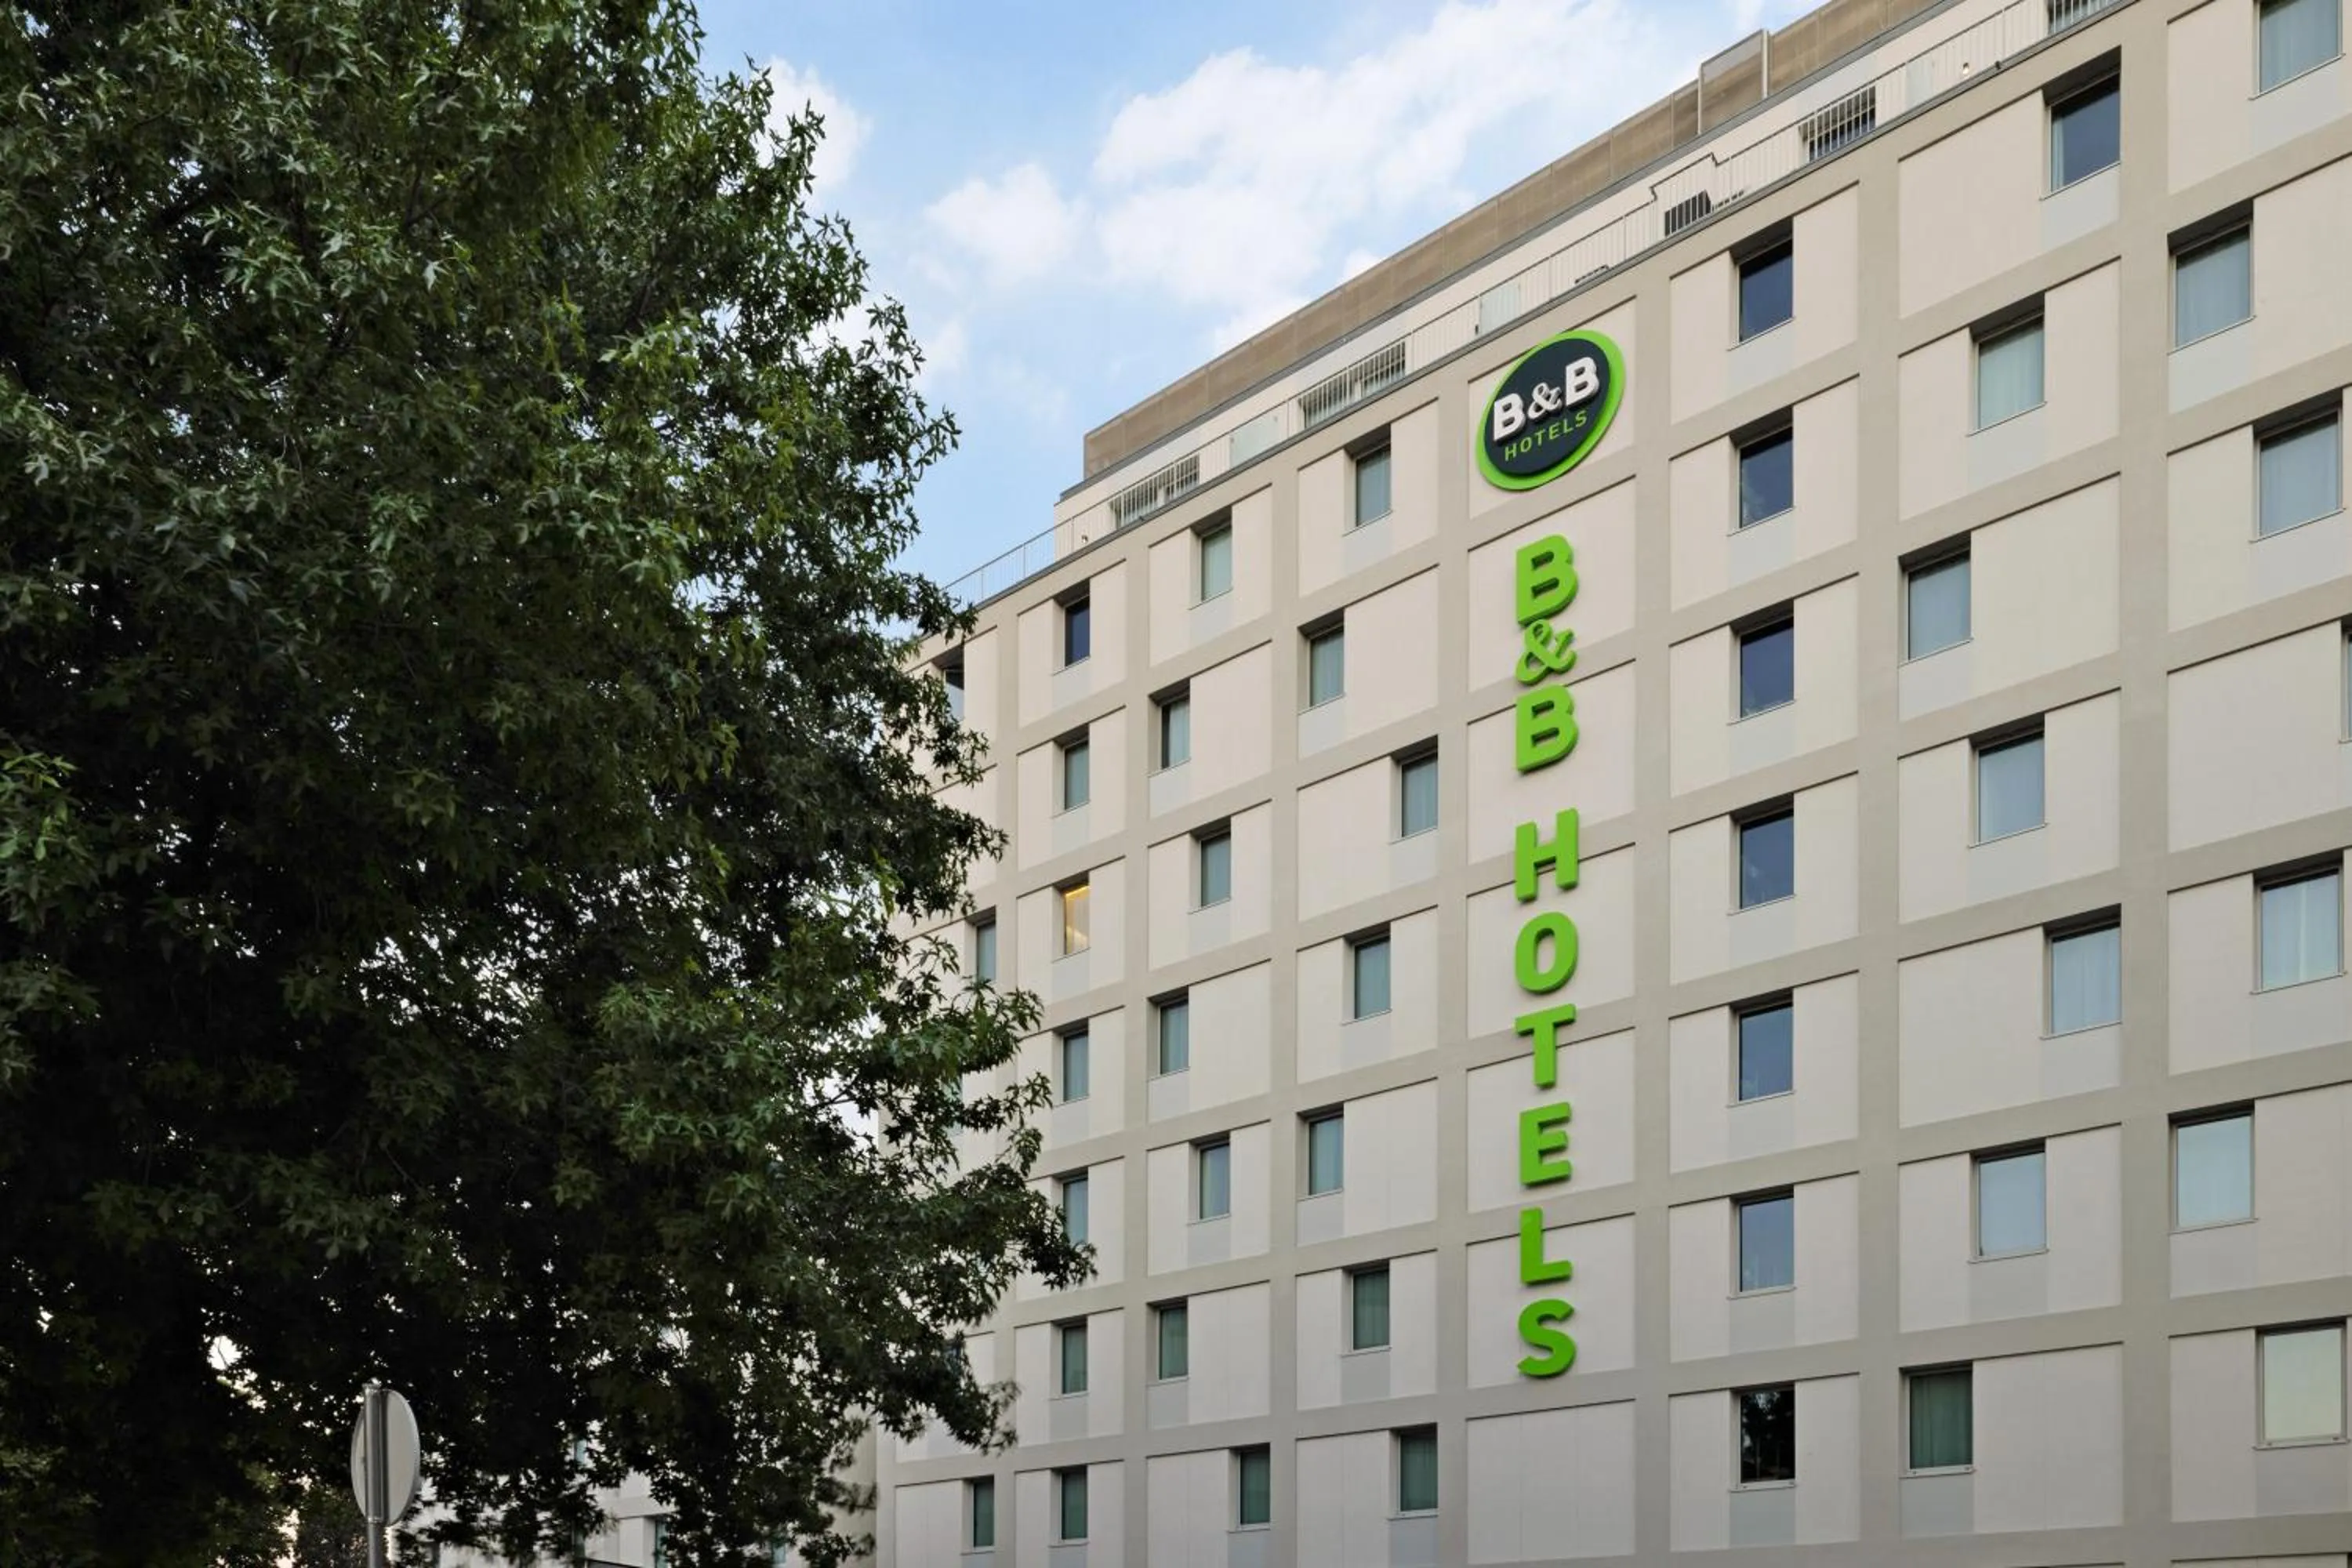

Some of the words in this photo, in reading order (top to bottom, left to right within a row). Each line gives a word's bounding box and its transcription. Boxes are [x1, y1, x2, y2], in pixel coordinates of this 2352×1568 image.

[1494, 357, 1599, 441] B&B
[1504, 410, 1588, 461] HOTELS
[1515, 535, 1579, 773] B&B
[1514, 808, 1580, 1377] HOTELS
